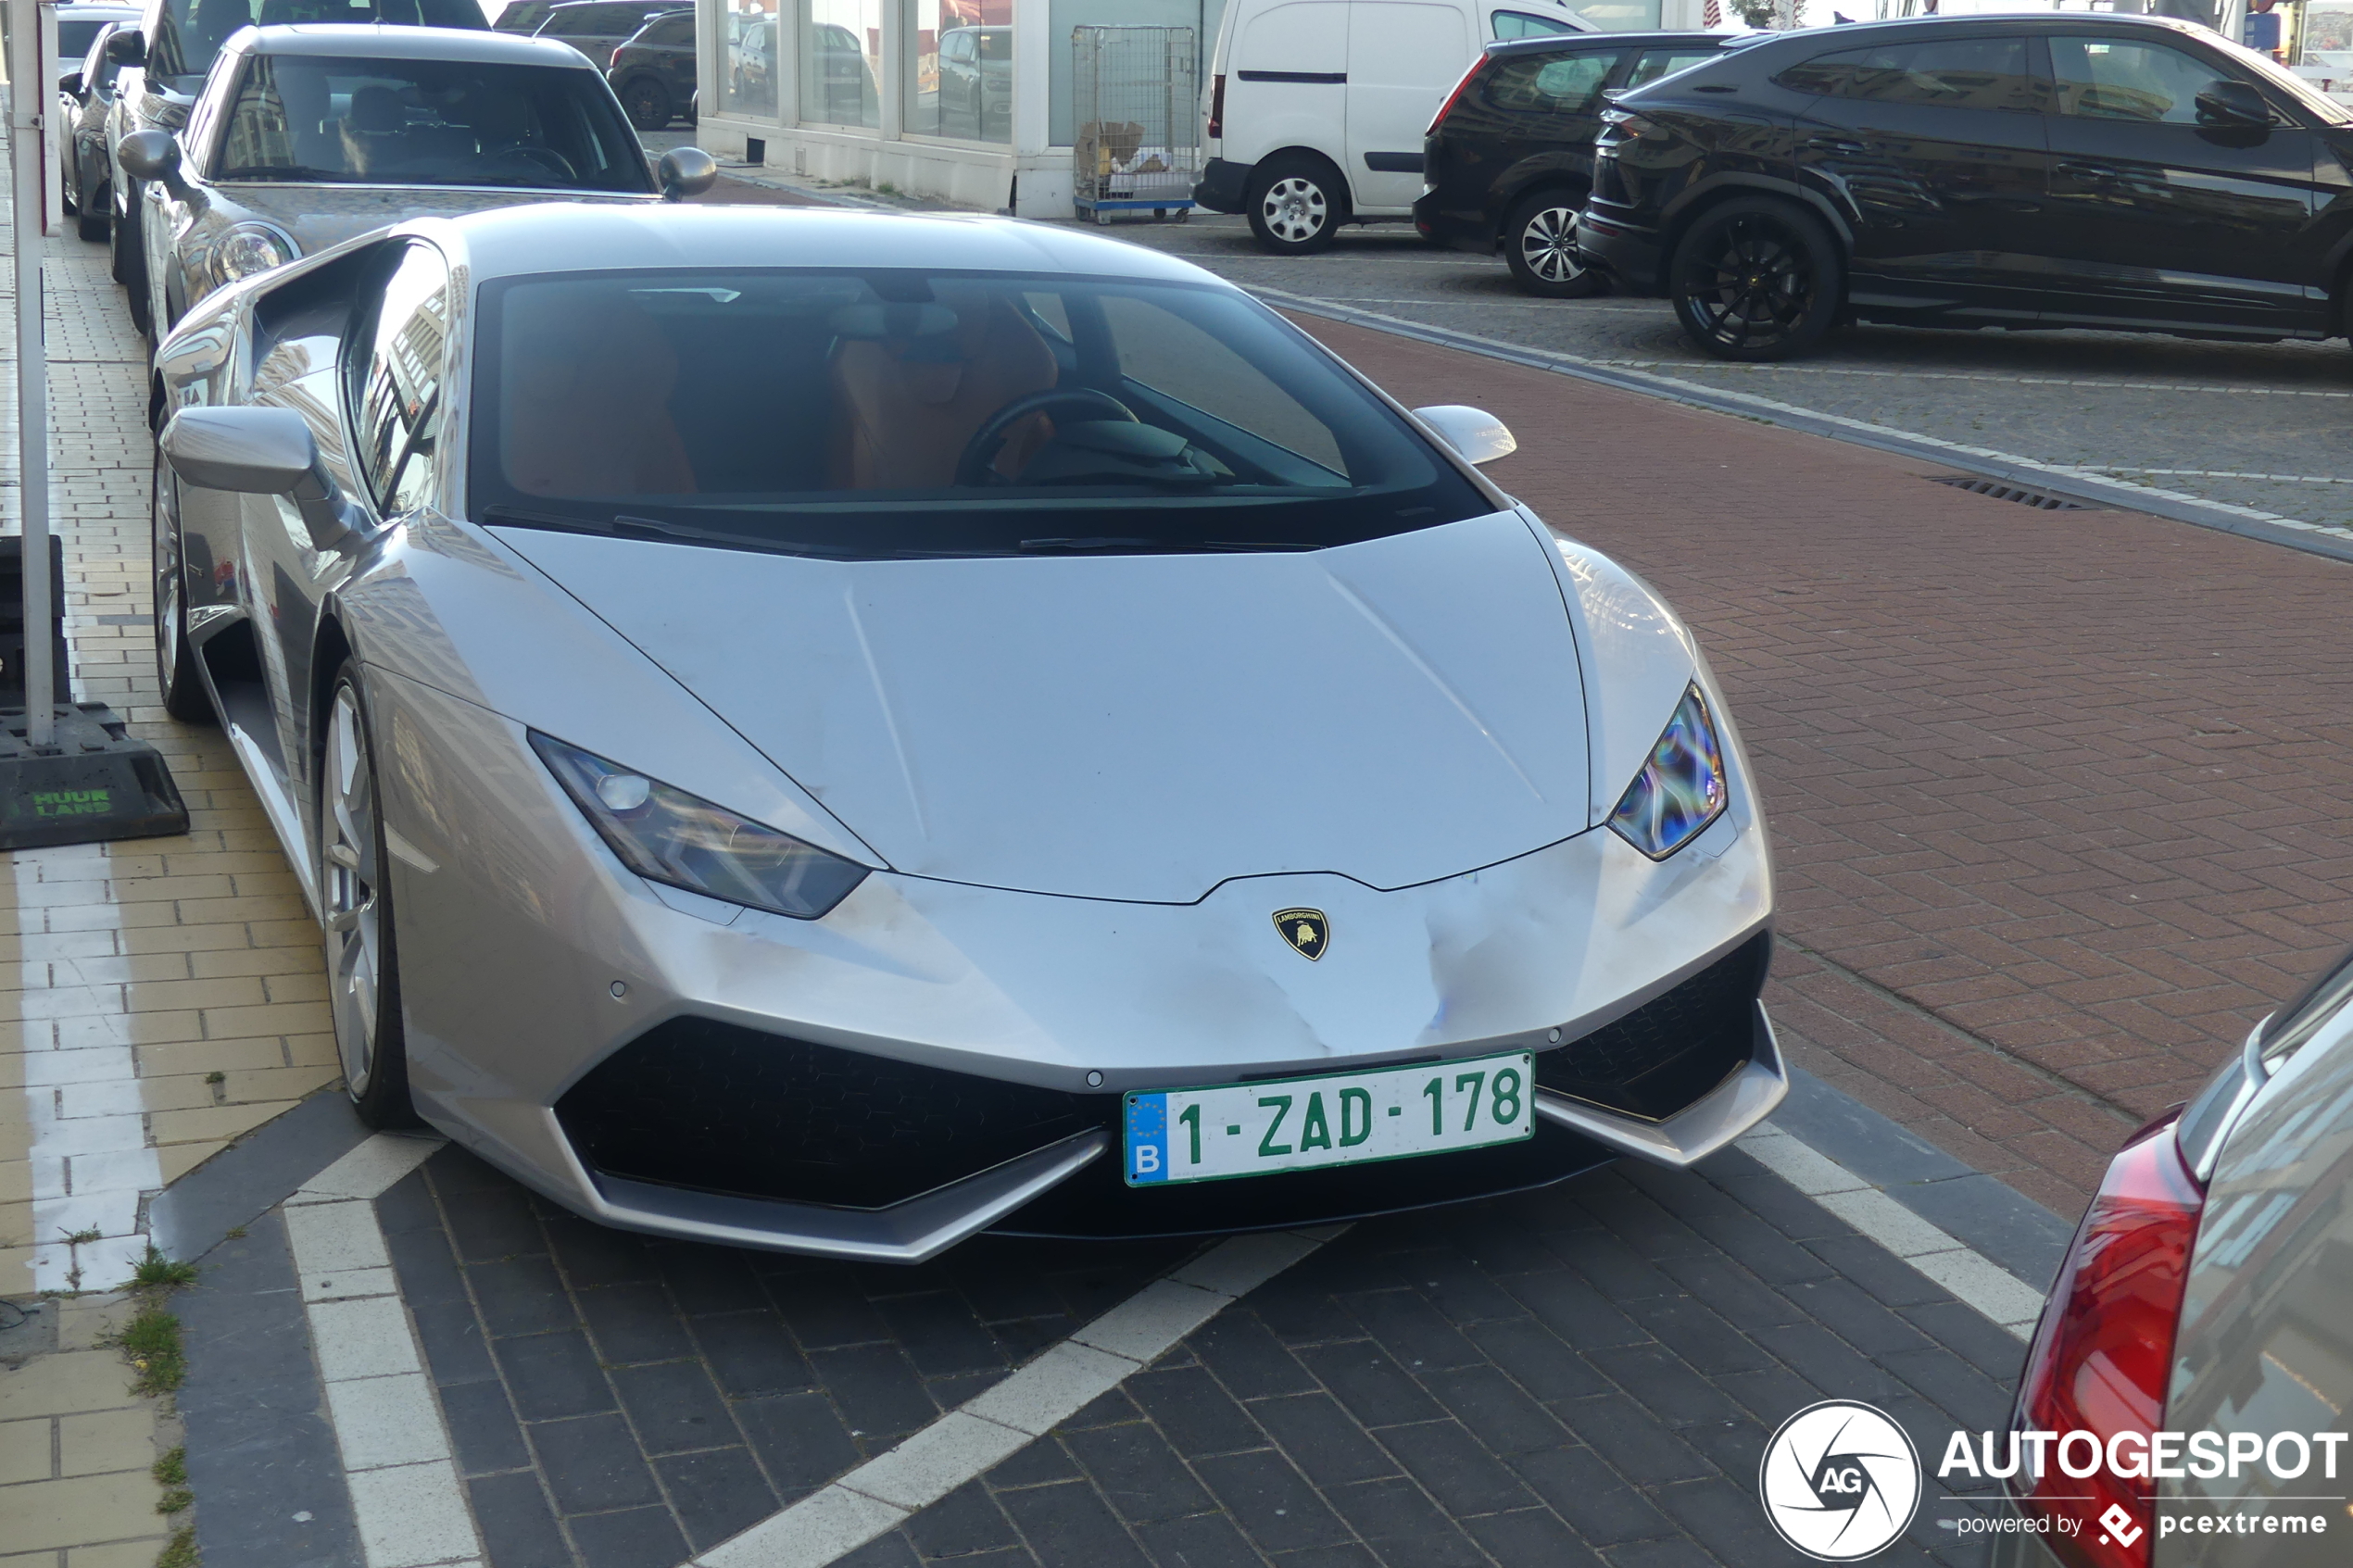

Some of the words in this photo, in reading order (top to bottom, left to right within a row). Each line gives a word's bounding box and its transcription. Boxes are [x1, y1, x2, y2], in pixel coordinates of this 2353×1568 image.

[33, 789, 109, 805] HUUR
[36, 802, 112, 816] LAND
[1277, 912, 1321, 923] LAMBORGHINI
[1179, 1067, 1521, 1165] 1-ZAD-178
[1137, 1145, 1160, 1173] B
